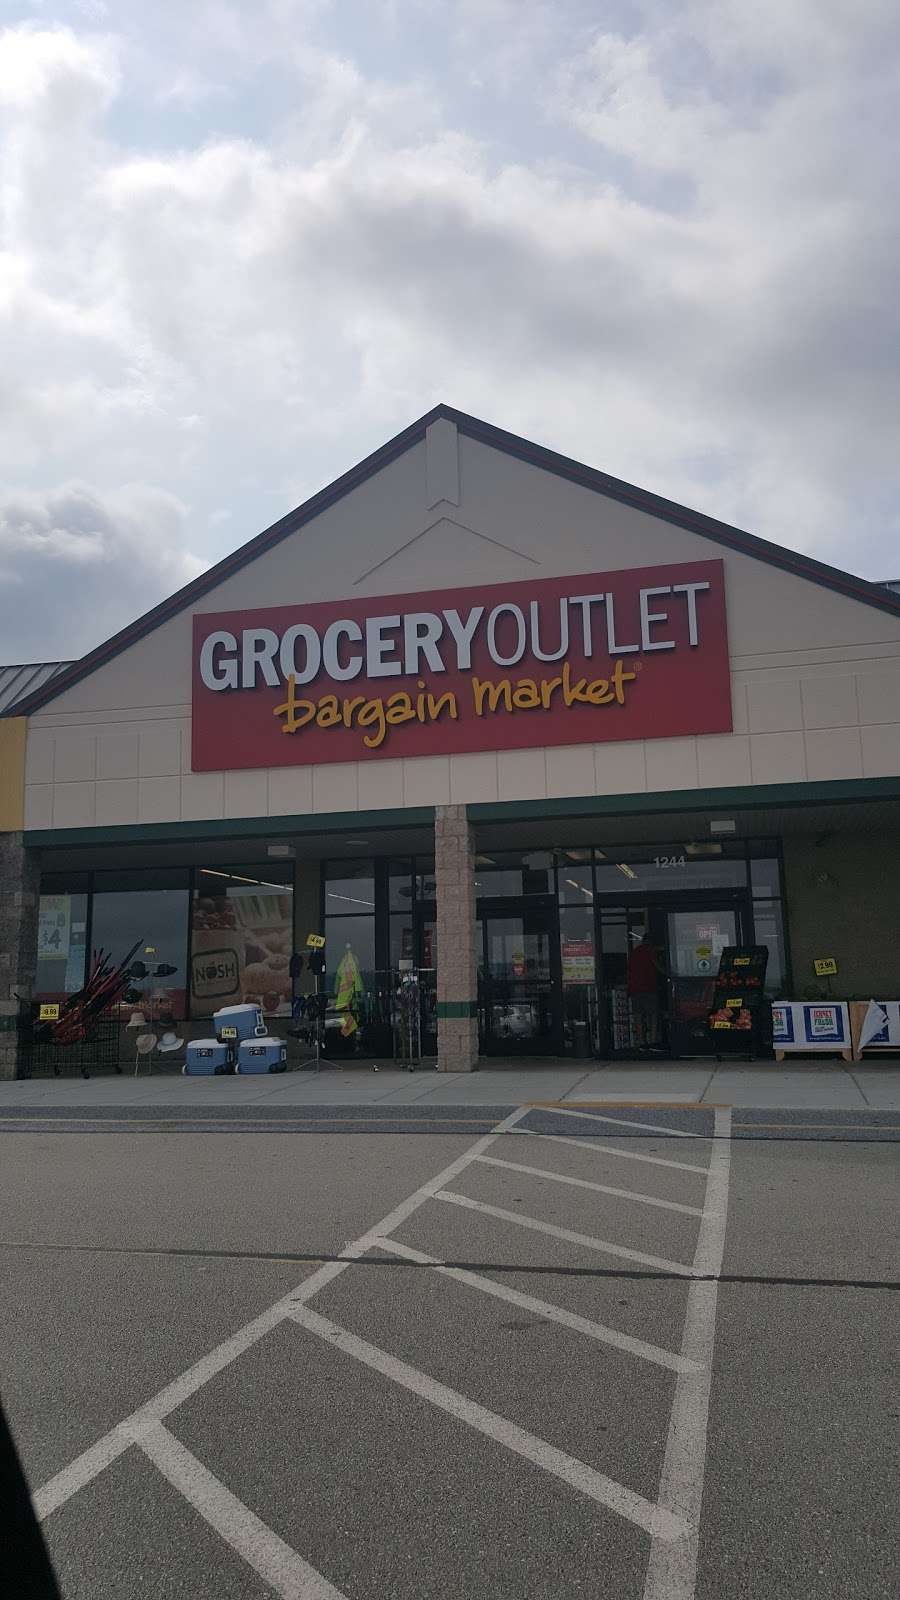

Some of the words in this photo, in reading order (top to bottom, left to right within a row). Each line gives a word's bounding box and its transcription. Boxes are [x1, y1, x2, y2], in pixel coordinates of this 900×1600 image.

[273, 674, 457, 748] bargain
[474, 660, 635, 716] market
[653, 855, 686, 869] 1244
